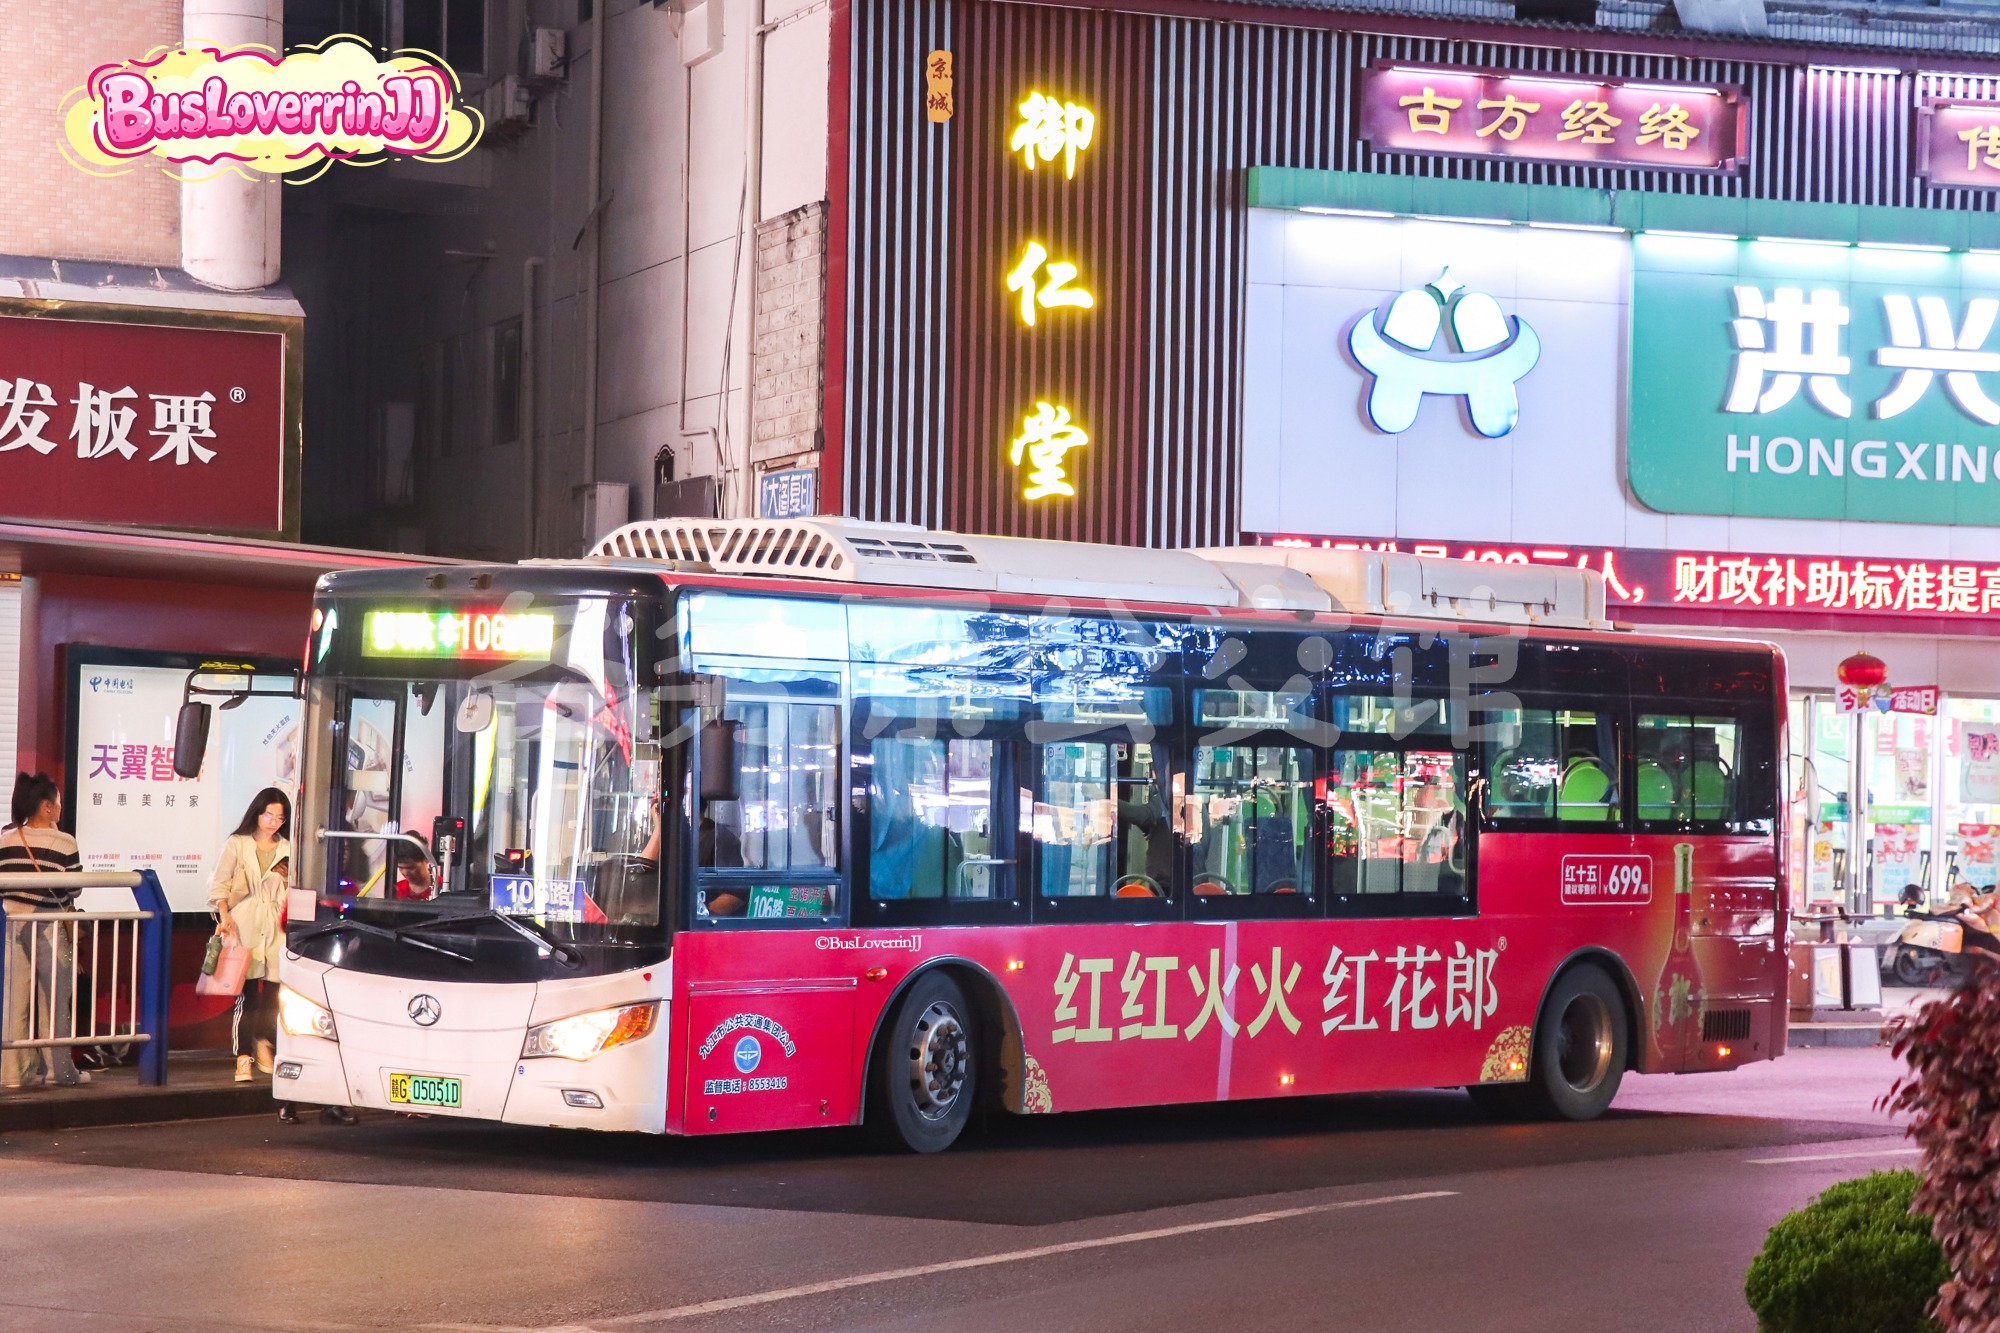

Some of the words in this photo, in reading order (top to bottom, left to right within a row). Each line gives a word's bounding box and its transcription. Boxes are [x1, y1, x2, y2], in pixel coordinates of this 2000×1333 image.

[928, 58, 952, 115] 京城
[1399, 86, 1699, 150] 古方经络
[1006, 90, 1095, 500] 御仁堂
[1725, 284, 2000, 425] 洪兴
[1727, 434, 2000, 483] HONGXIN
[92, 792, 199, 808] 智惠美好家
[1565, 864, 1597, 882] 红十五
[753, 895, 784, 917] 106路
[1052, 946, 1302, 1044] 红红火火
[1321, 940, 1500, 1032] 红花郎
[699, 1013, 796, 1060] 九江市公共交通集团公司
